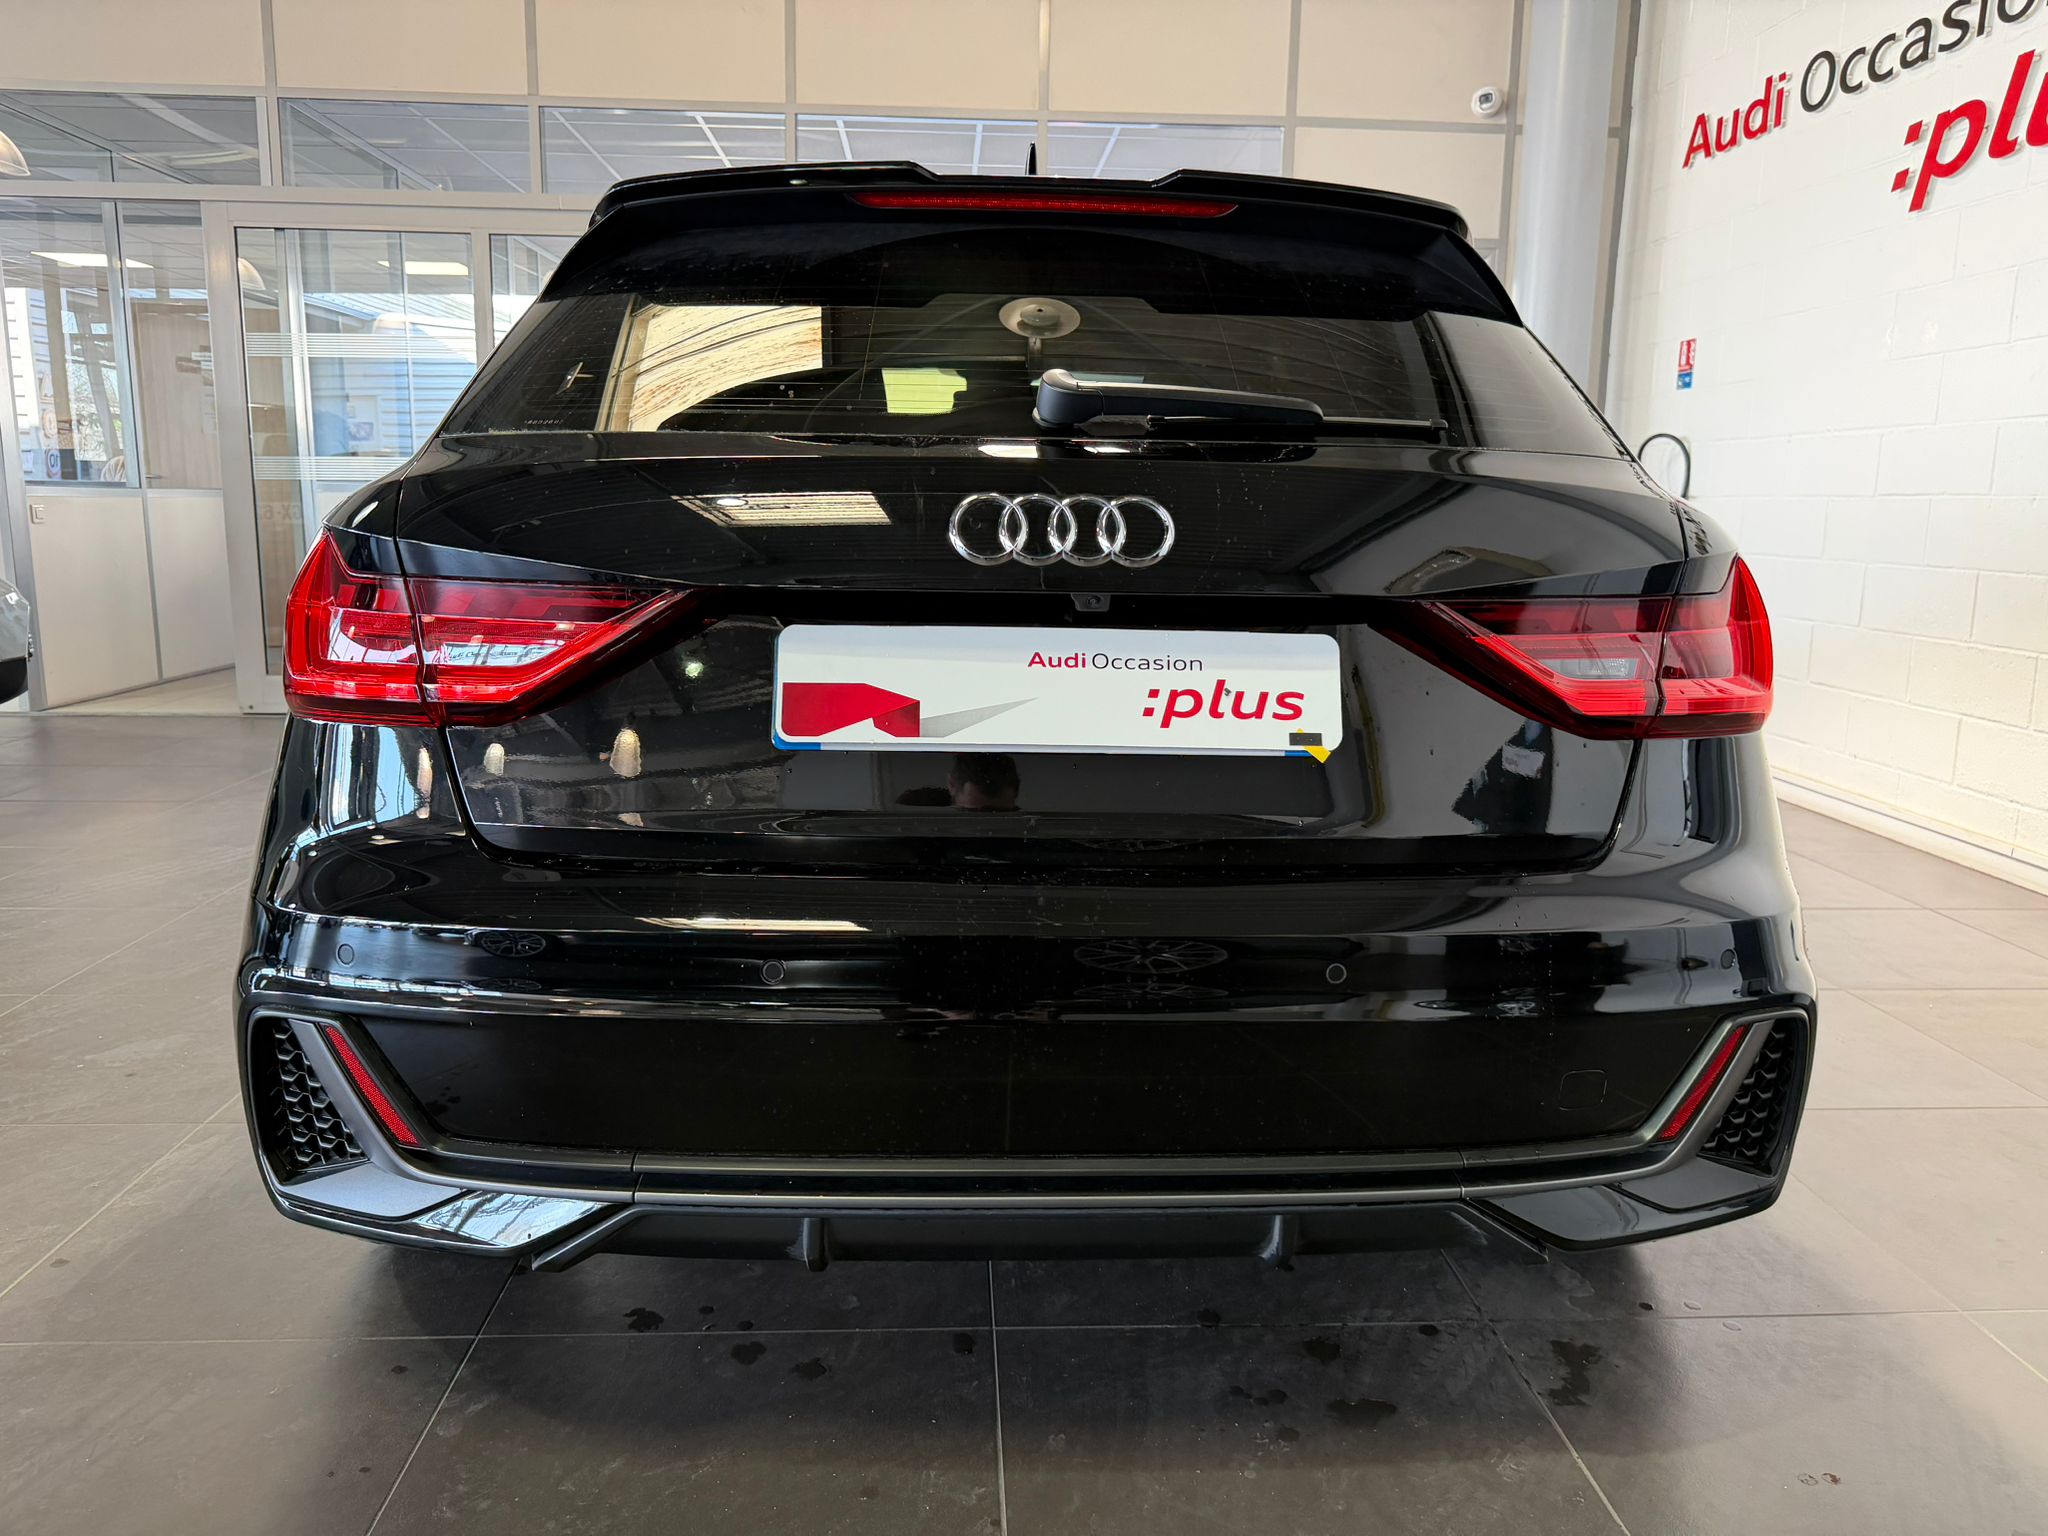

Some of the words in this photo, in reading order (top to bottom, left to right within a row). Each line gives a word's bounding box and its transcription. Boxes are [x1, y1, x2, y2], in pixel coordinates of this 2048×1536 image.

[1682, 72, 1787, 168] Audi
[1027, 651, 1086, 669] Audi
[1091, 652, 1203, 672] Occasion
